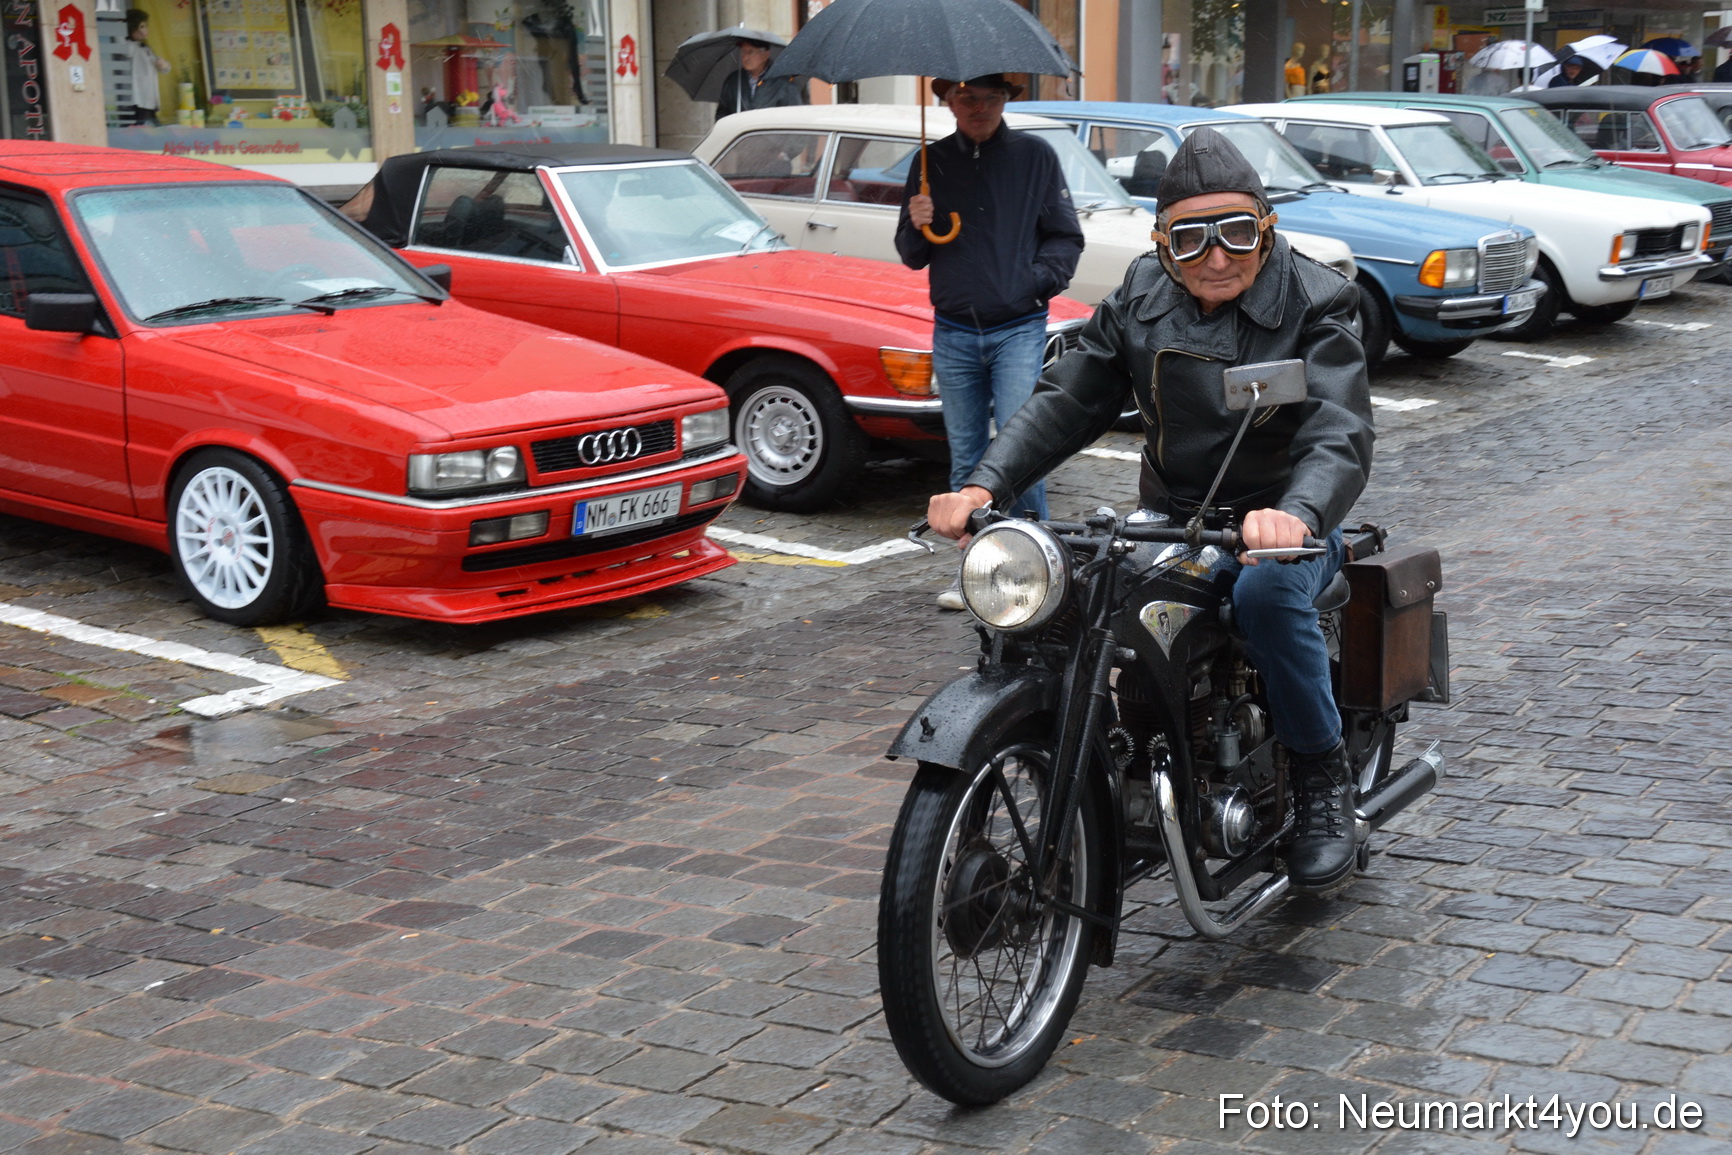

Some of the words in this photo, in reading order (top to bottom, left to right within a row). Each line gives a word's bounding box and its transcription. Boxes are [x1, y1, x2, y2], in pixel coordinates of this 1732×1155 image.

[194, 140, 211, 154] für
[213, 140, 236, 154] Ihre
[586, 501, 609, 529] NM
[618, 496, 640, 523] FK
[642, 490, 670, 517] 666
